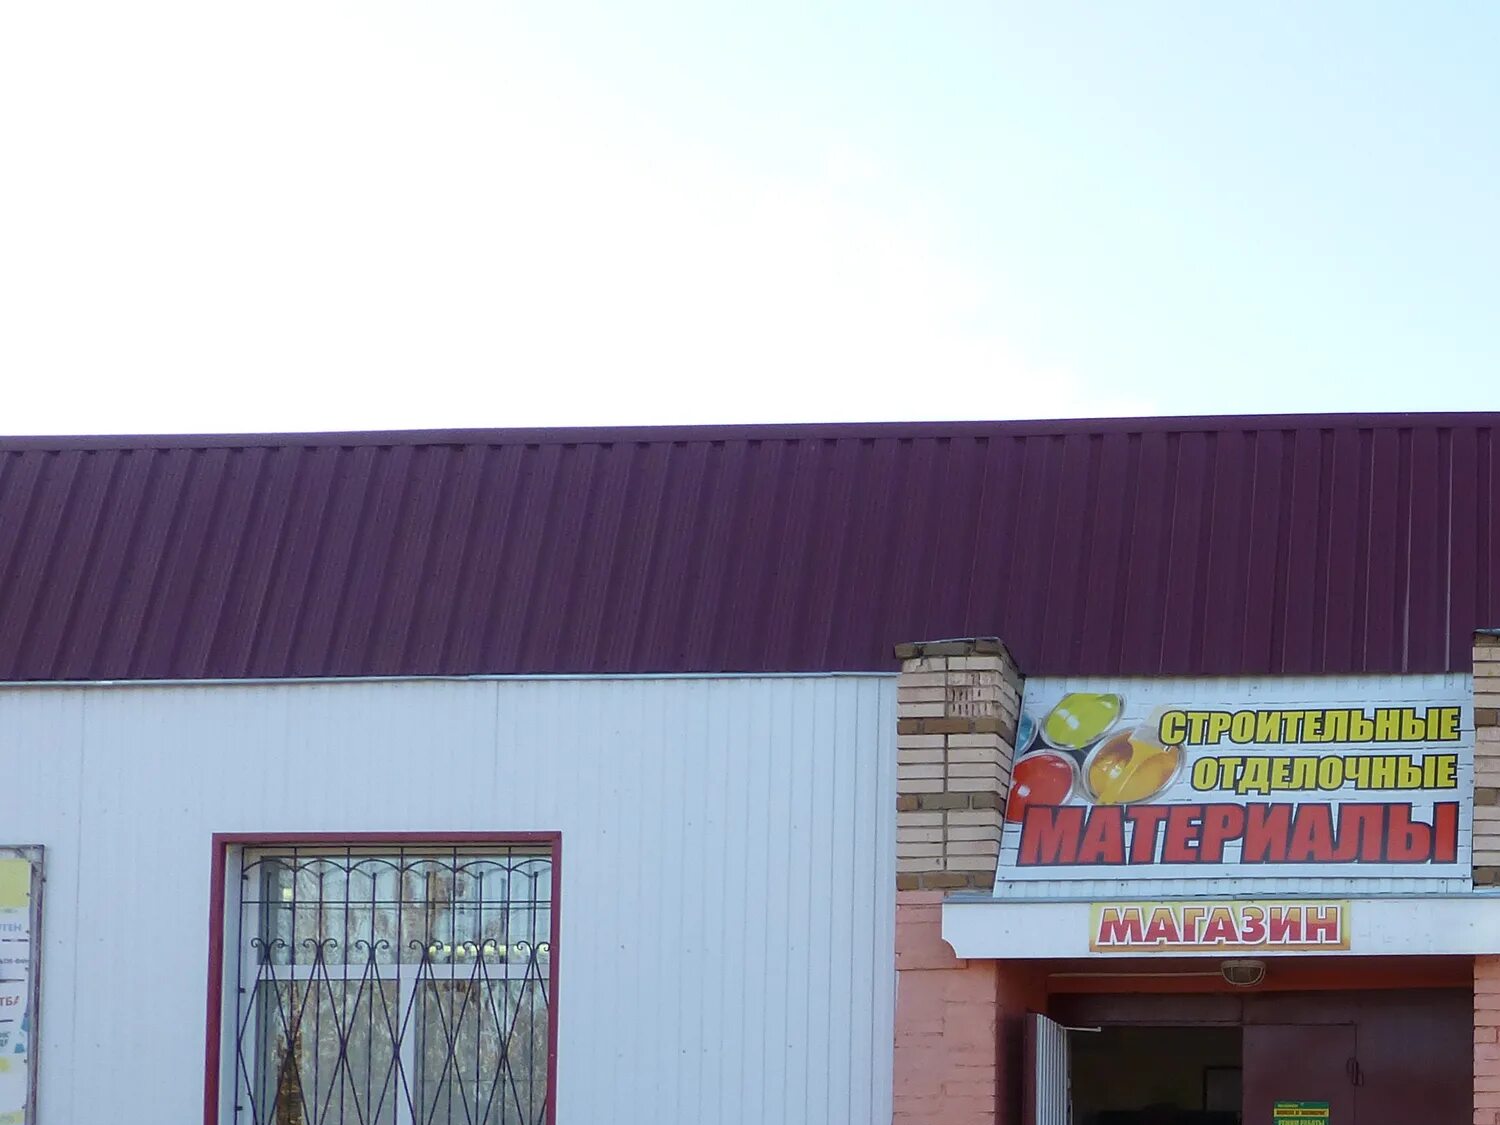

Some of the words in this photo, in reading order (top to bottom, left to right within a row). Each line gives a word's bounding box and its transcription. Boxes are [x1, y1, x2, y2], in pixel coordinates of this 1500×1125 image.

[1159, 706, 1462, 746] СТРОИТЕЛЬНЫЕ
[1190, 753, 1459, 795] ОТДЕЛОЧНЫЕ
[1016, 801, 1460, 867] МАТЕРИАЛЫ
[1096, 905, 1341, 945] МАГАЗИН
